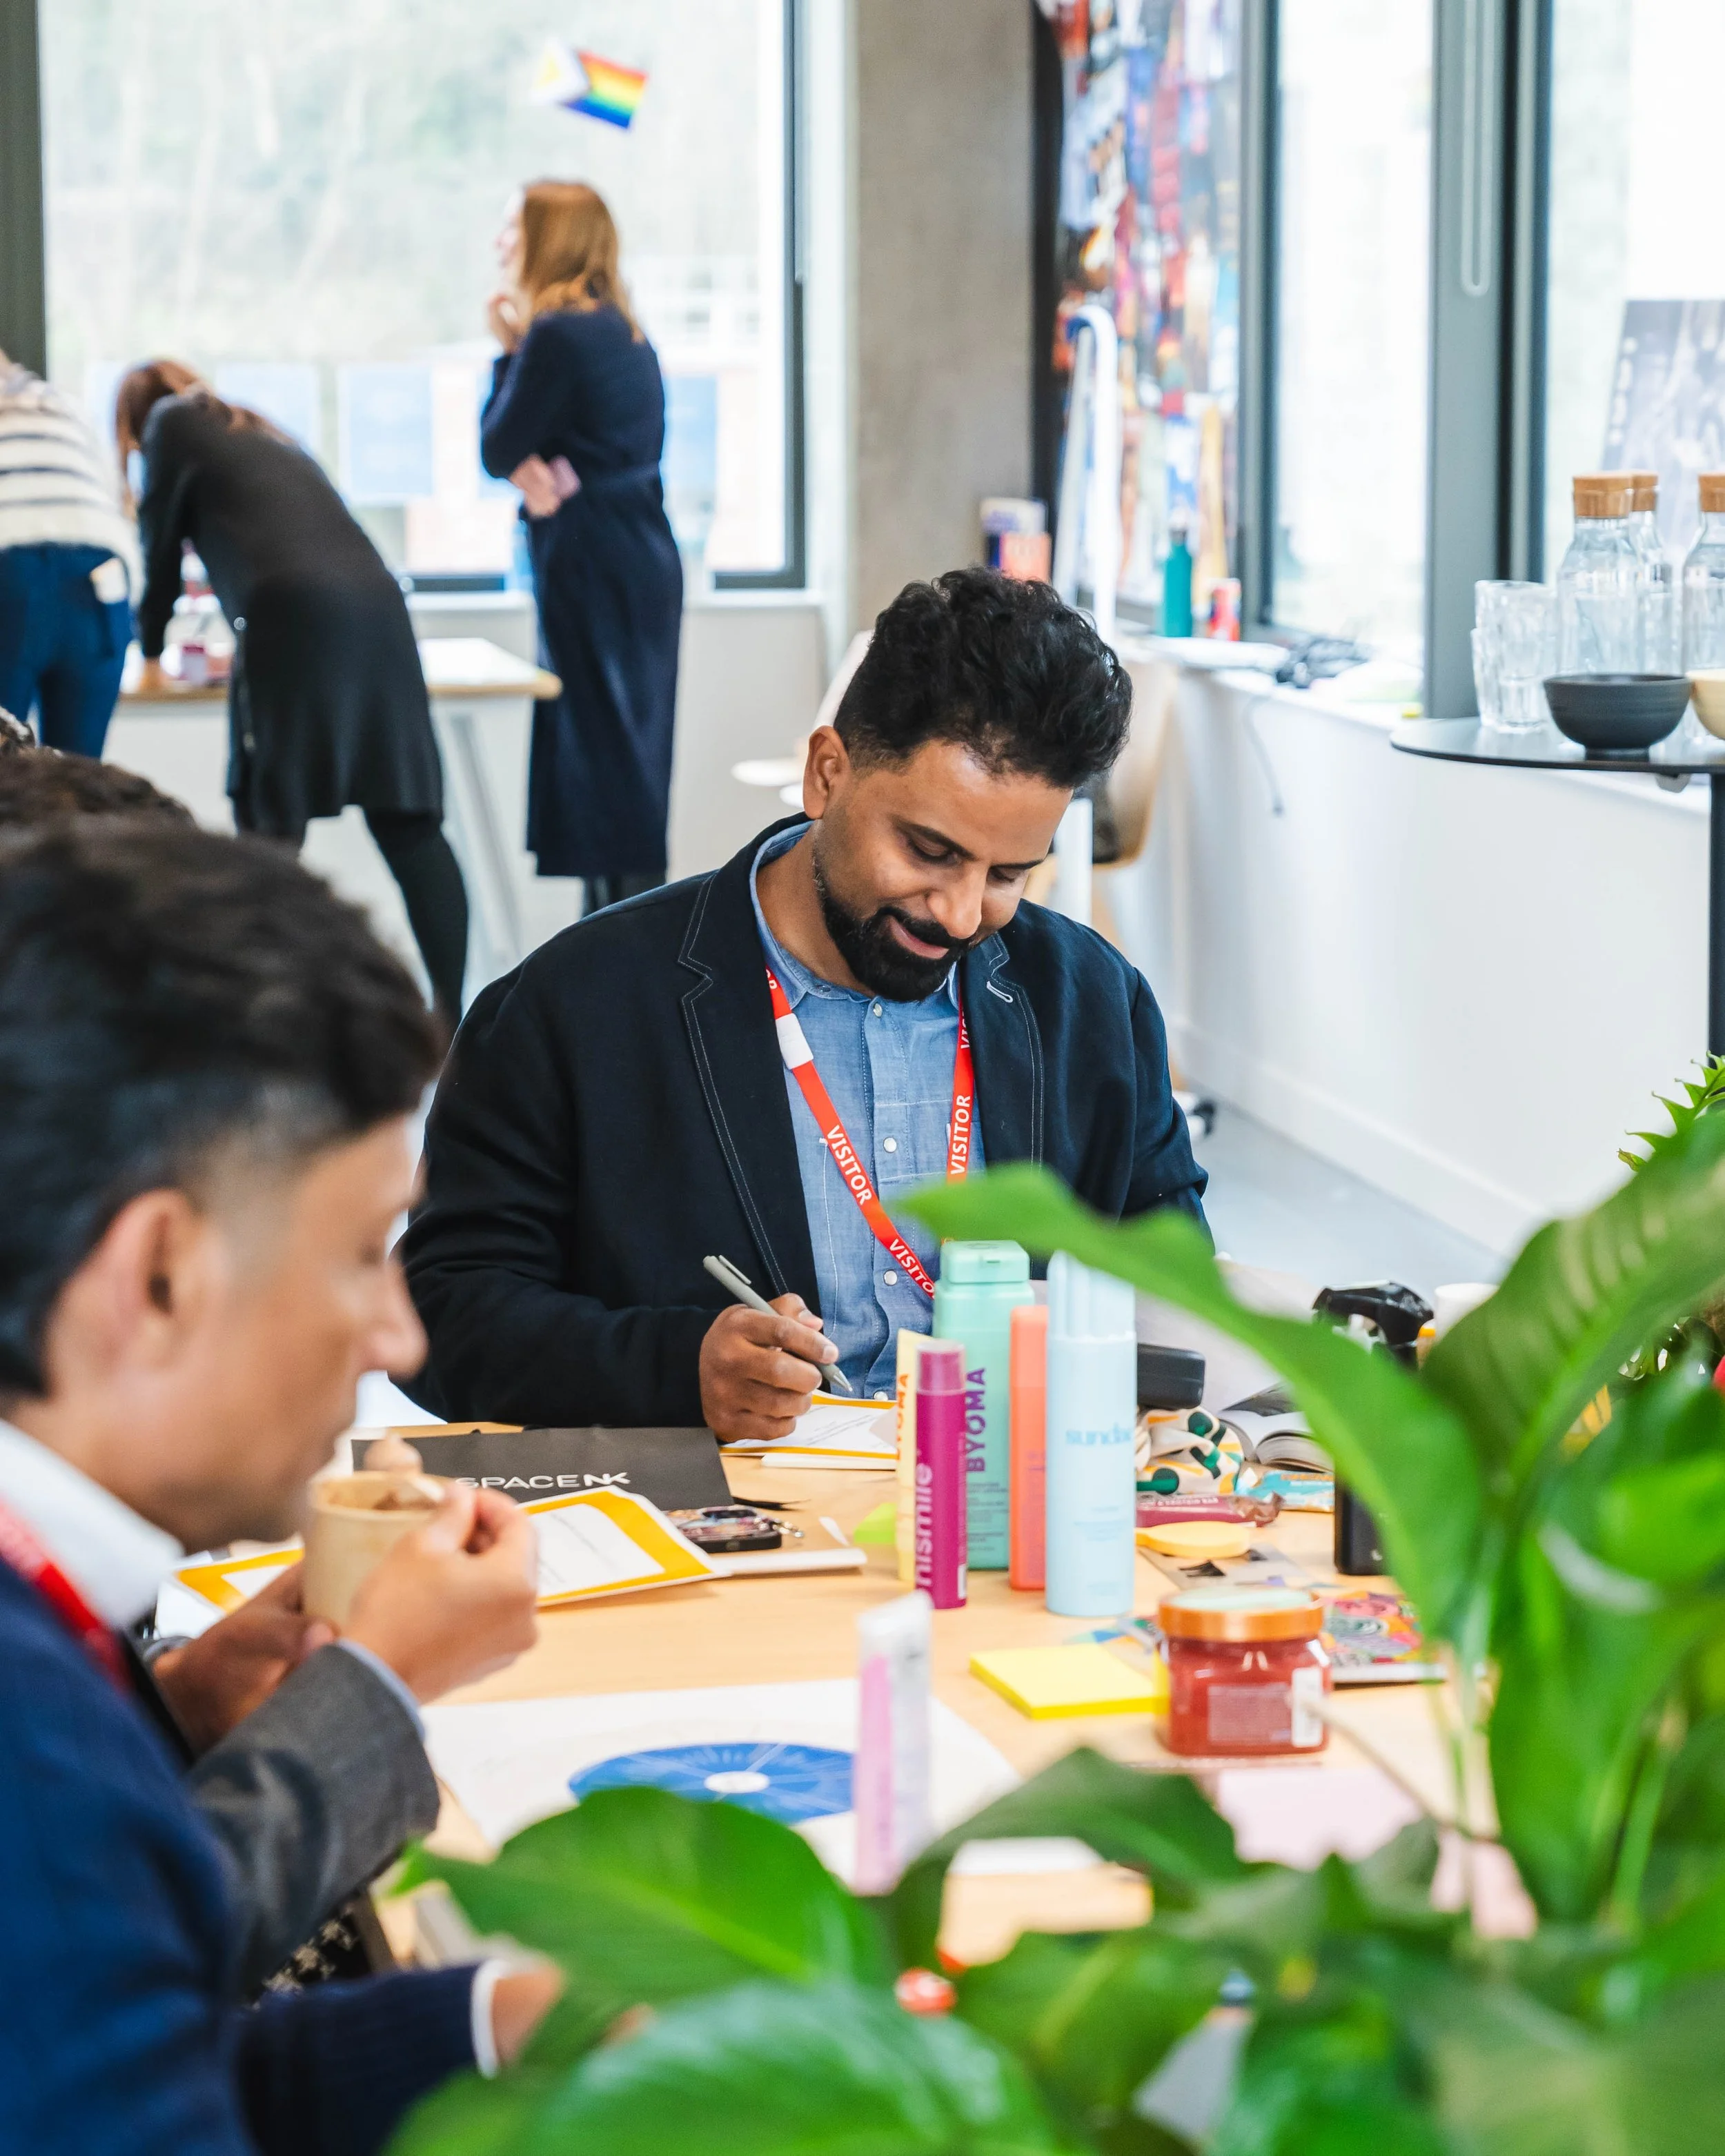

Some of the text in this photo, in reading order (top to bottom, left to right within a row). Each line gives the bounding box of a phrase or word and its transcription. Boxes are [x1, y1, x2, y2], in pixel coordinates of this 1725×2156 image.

[827, 1125, 873, 1206] VISITOR
[950, 1095, 971, 1175] VISITOR
[889, 1238, 934, 1298] VISITO
[965, 1368, 986, 1472] BYOMA
